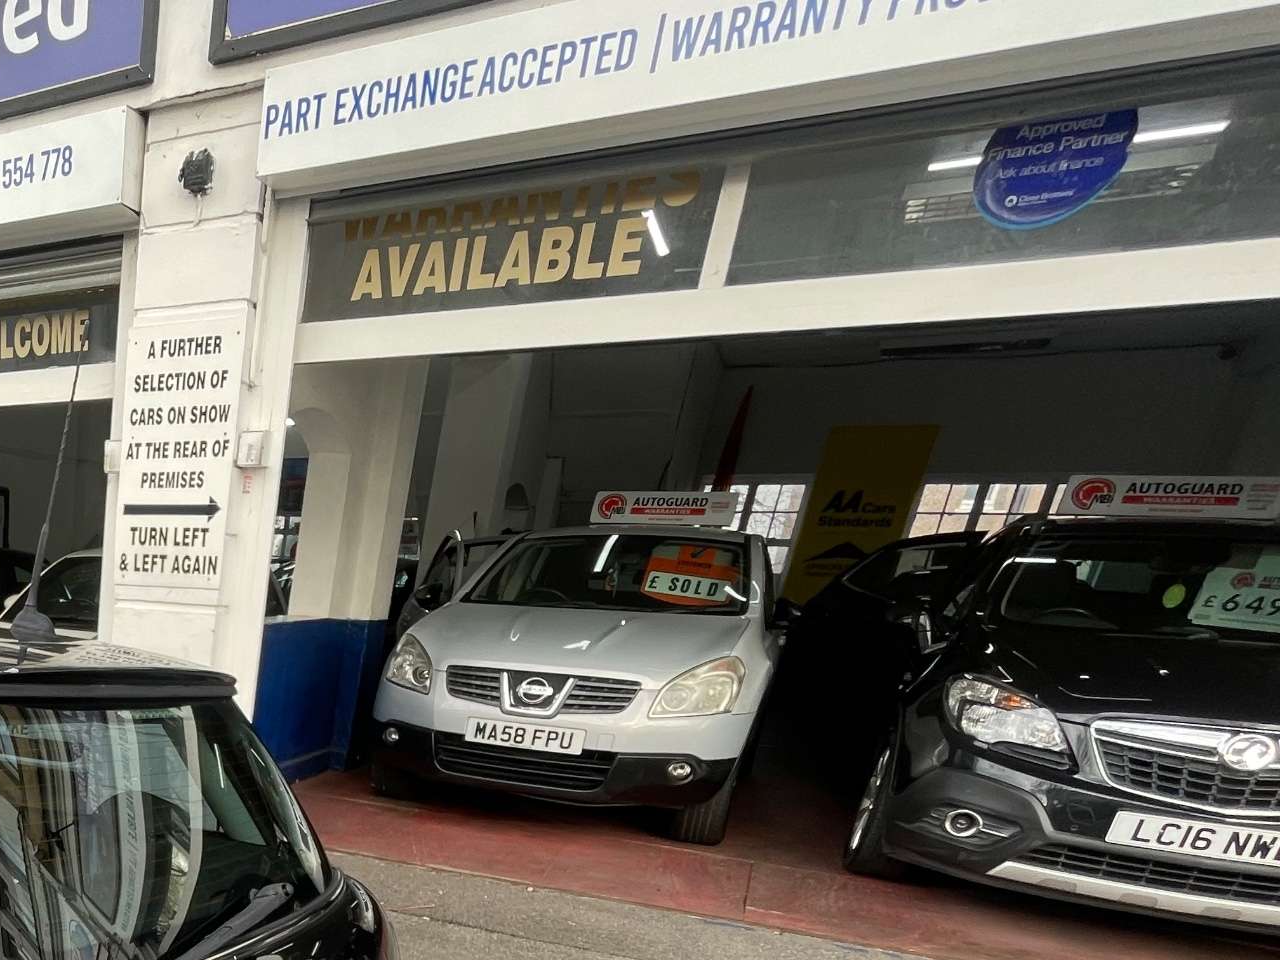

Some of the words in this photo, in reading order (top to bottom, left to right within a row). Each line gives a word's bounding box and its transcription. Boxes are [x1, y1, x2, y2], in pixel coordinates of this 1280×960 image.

[264, 93, 327, 140] PART
[1017, 114, 1106, 140] Approved
[988, 142, 1054, 161] Finance
[1059, 131, 1128, 150] Partner
[2, 154, 35, 189] 554
[41, 145, 73, 181] 778
[1019, 161, 1057, 176] about
[1058, 157, 1104, 172] finance
[350, 217, 649, 302] AVAILABLE
[147, 341, 156, 360] A
[160, 336, 222, 358] FURTHER
[134, 371, 206, 393] SELECTION
[210, 370, 228, 389] OF
[130, 408, 163, 426] CARS
[168, 406, 186, 424] ON
[190, 404, 231, 424] SHOW
[126, 442, 142, 460] AT
[145, 442, 169, 459] THE
[173, 440, 207, 459] REAR
[212, 439, 230, 458] OF
[140, 471, 205, 489] PREMISES
[1126, 483, 1244, 495] AUTOGUARD
[633, 497, 709, 507] AUTOGUARD
[823, 489, 865, 513] AA
[818, 515, 892, 528] Standards
[130, 527, 168, 546] TURN
[173, 527, 210, 548] LEFT
[120, 553, 129, 572] &
[134, 554, 168, 573] LEFT
[171, 555, 218, 575] AGAIN
[668, 576, 719, 597] SOLD
[474, 722, 526, 744] MA58
[531, 729, 574, 749] FPU
[1131, 819, 1216, 851] LC16
